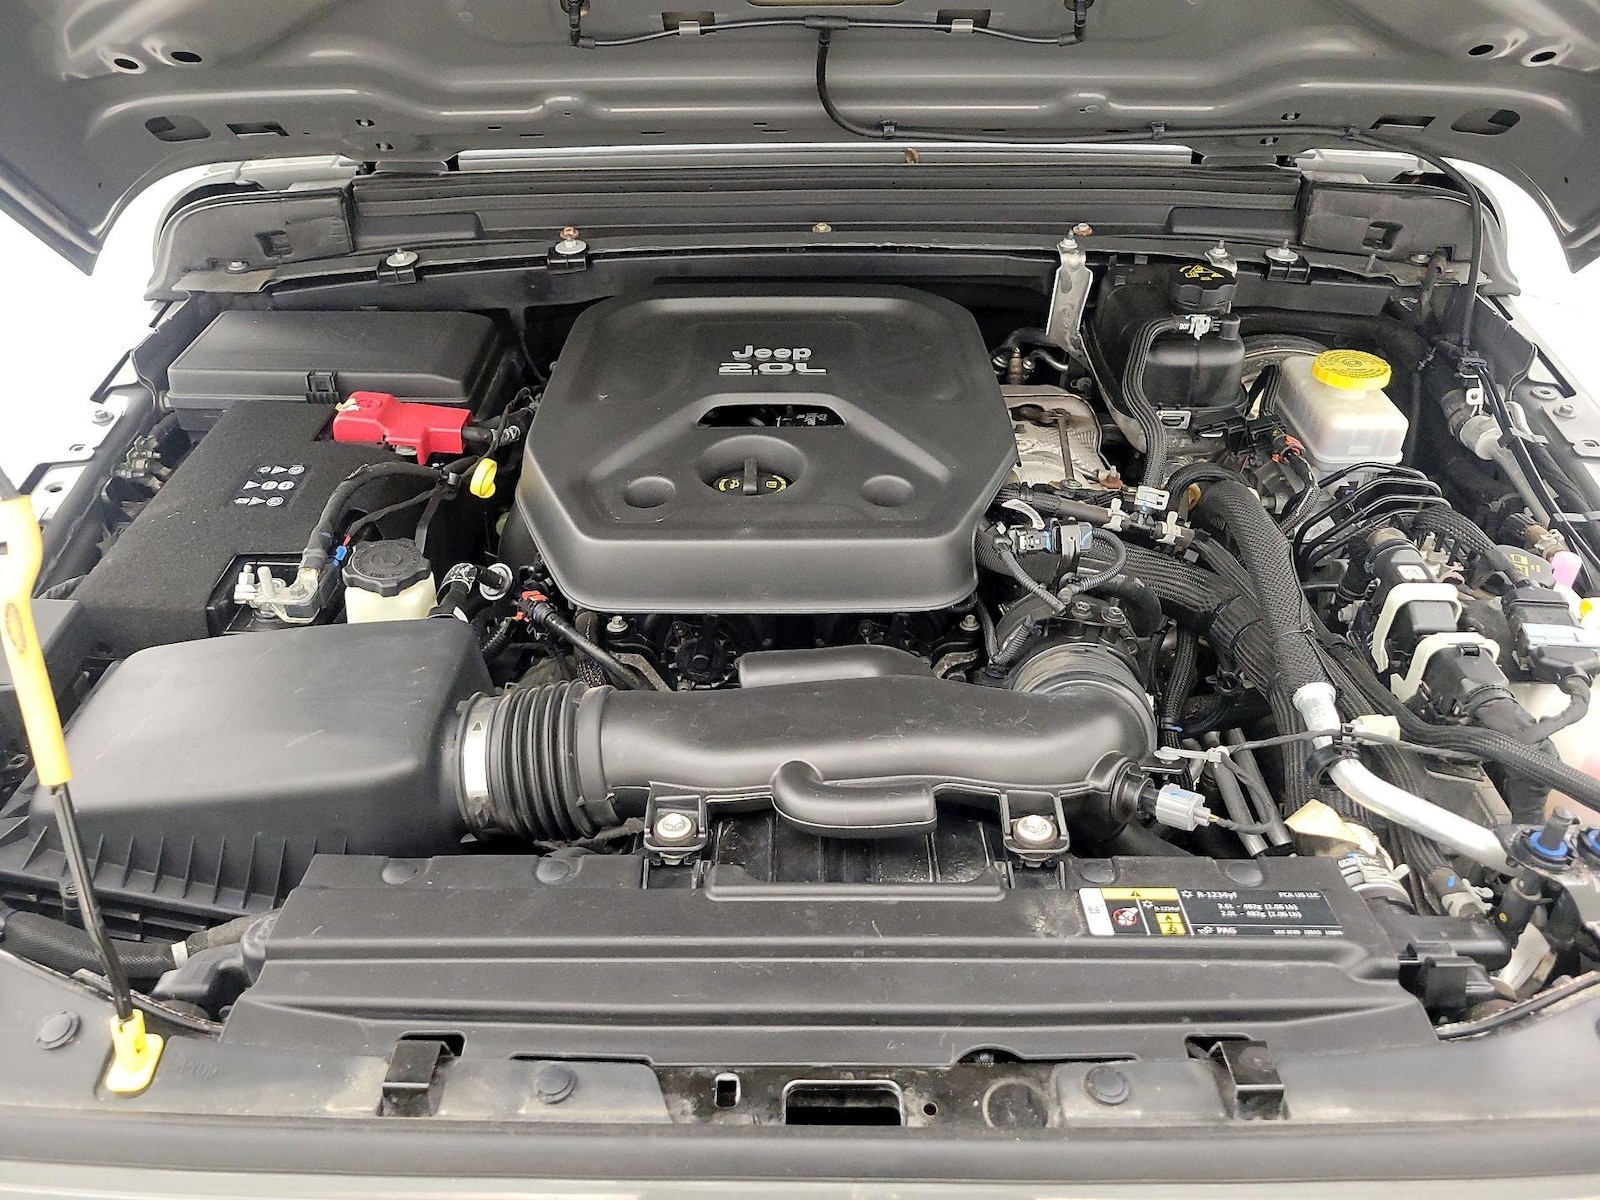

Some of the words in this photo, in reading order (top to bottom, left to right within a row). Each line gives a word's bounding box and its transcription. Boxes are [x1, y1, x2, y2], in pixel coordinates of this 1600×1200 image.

[731, 345, 812, 361] Jeep
[718, 362, 827, 376] 2.0L
[1197, 891, 1238, 900] R-1234yf
[1216, 926, 1238, 935] PAG
